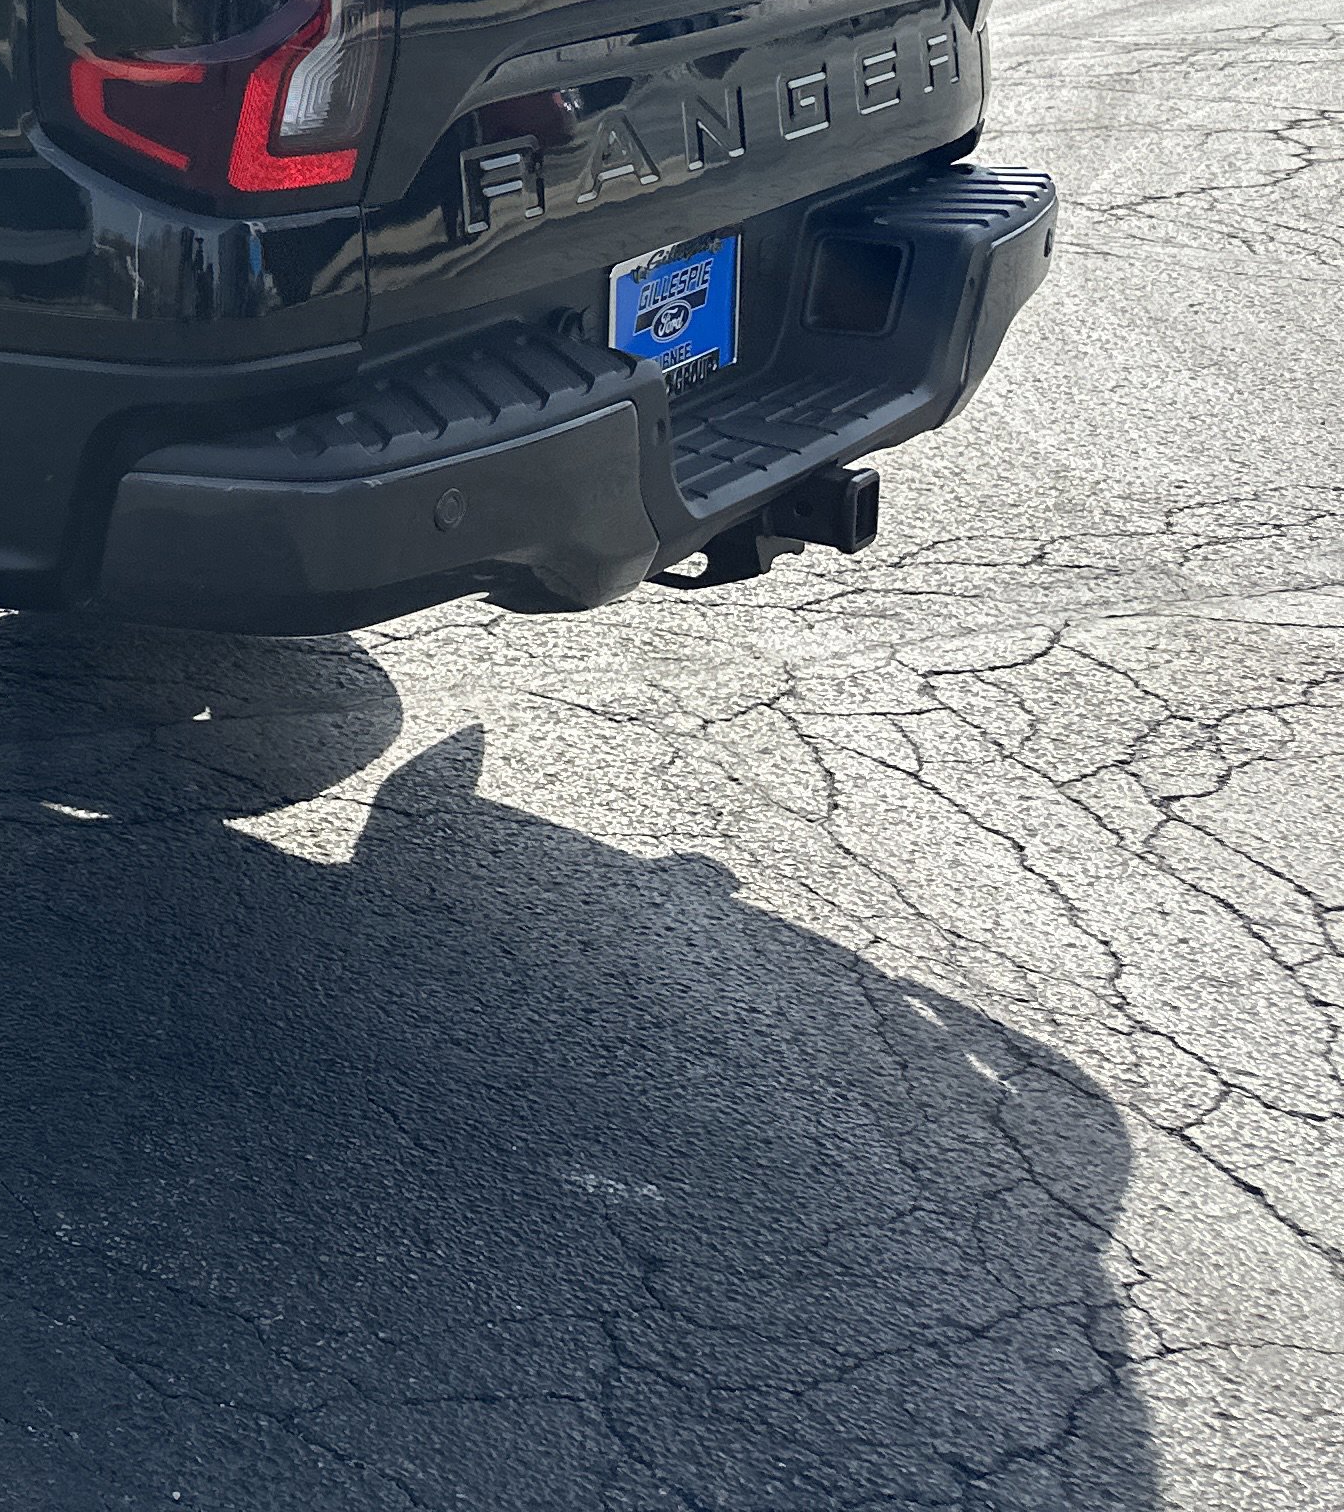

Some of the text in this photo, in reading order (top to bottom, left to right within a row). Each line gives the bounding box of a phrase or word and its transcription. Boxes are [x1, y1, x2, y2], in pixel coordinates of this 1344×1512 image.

[459, 22, 962, 234] RANGER
[638, 257, 714, 312] GILLESPIE
[658, 307, 685, 337] Ford
